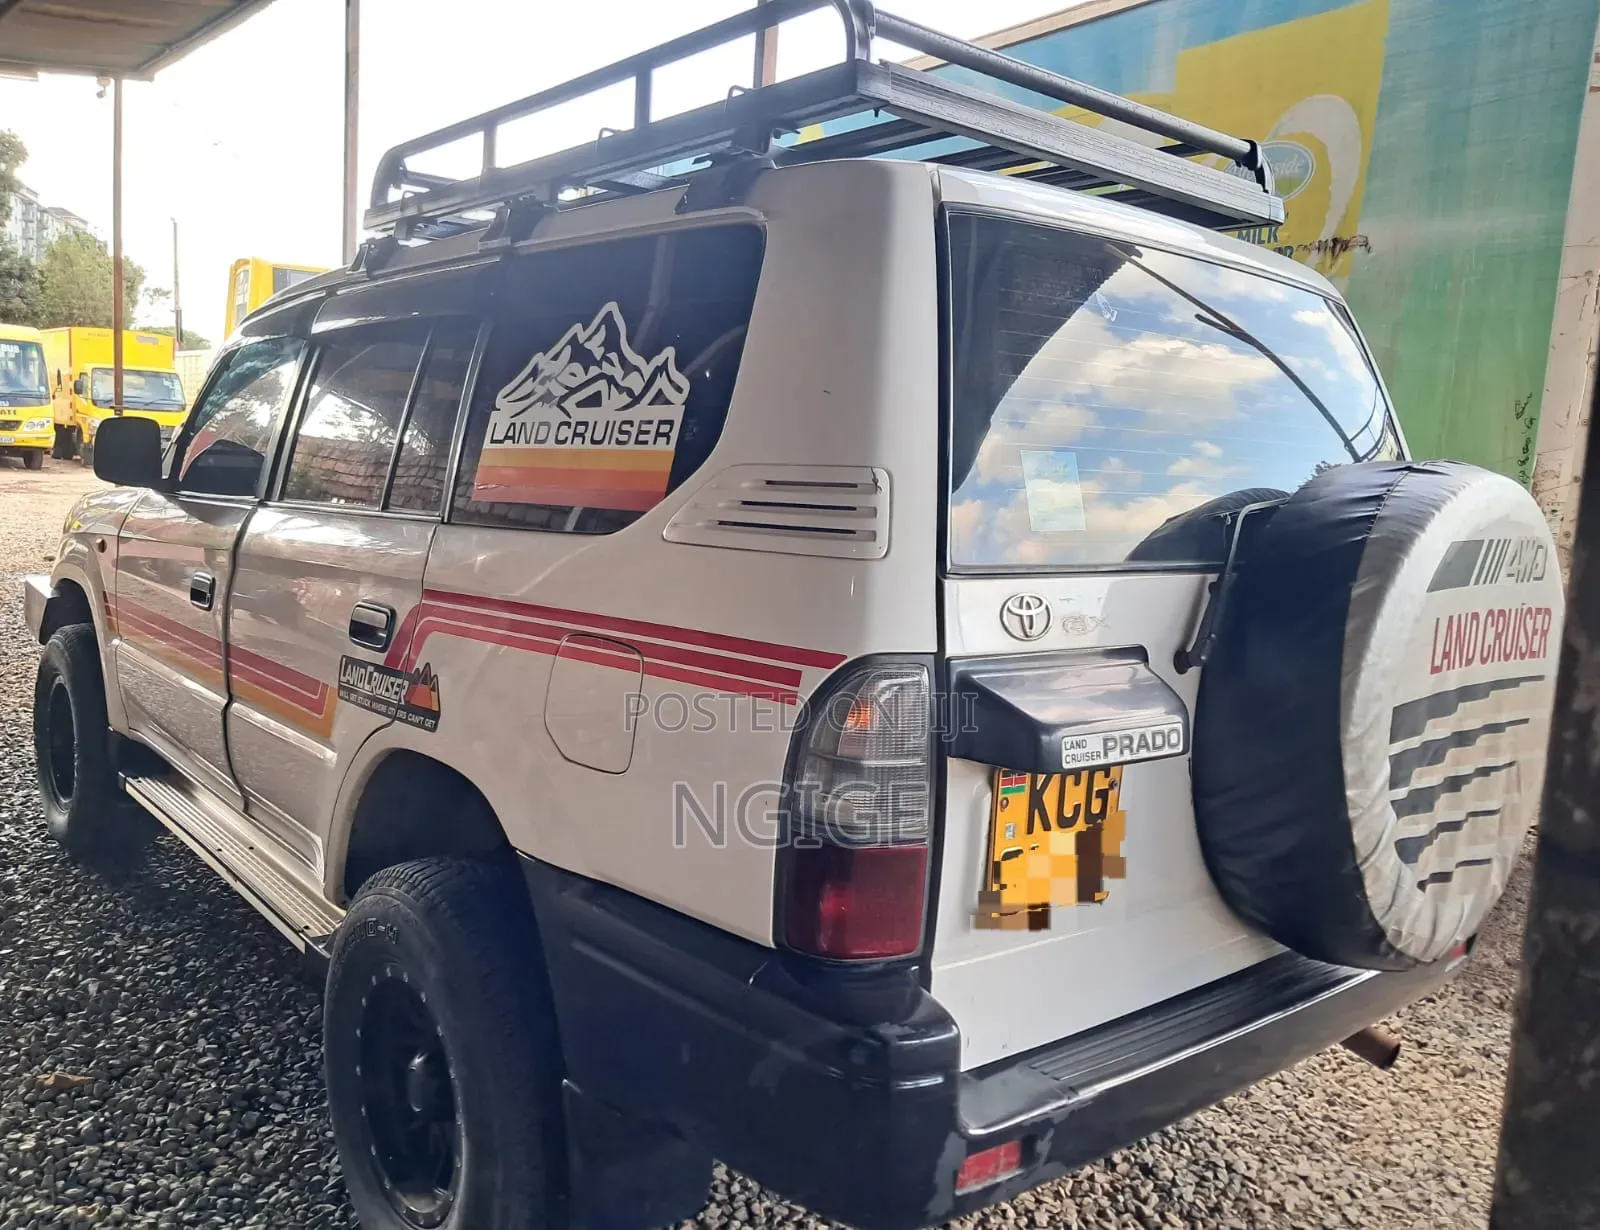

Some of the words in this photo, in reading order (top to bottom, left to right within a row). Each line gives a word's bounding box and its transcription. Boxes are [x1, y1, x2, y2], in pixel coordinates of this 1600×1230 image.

[1237, 225, 1280, 245] MILK
[489, 421, 551, 445] LAND
[554, 419, 675, 445] CRUISER
[1430, 611, 1480, 675] LAND
[1479, 603, 1552, 666] CRUISER
[1064, 739, 1087, 751] LAND
[1102, 728, 1181, 759] PRADO
[1065, 750, 1101, 764] CRUISER
[1026, 766, 1112, 835] KCG
